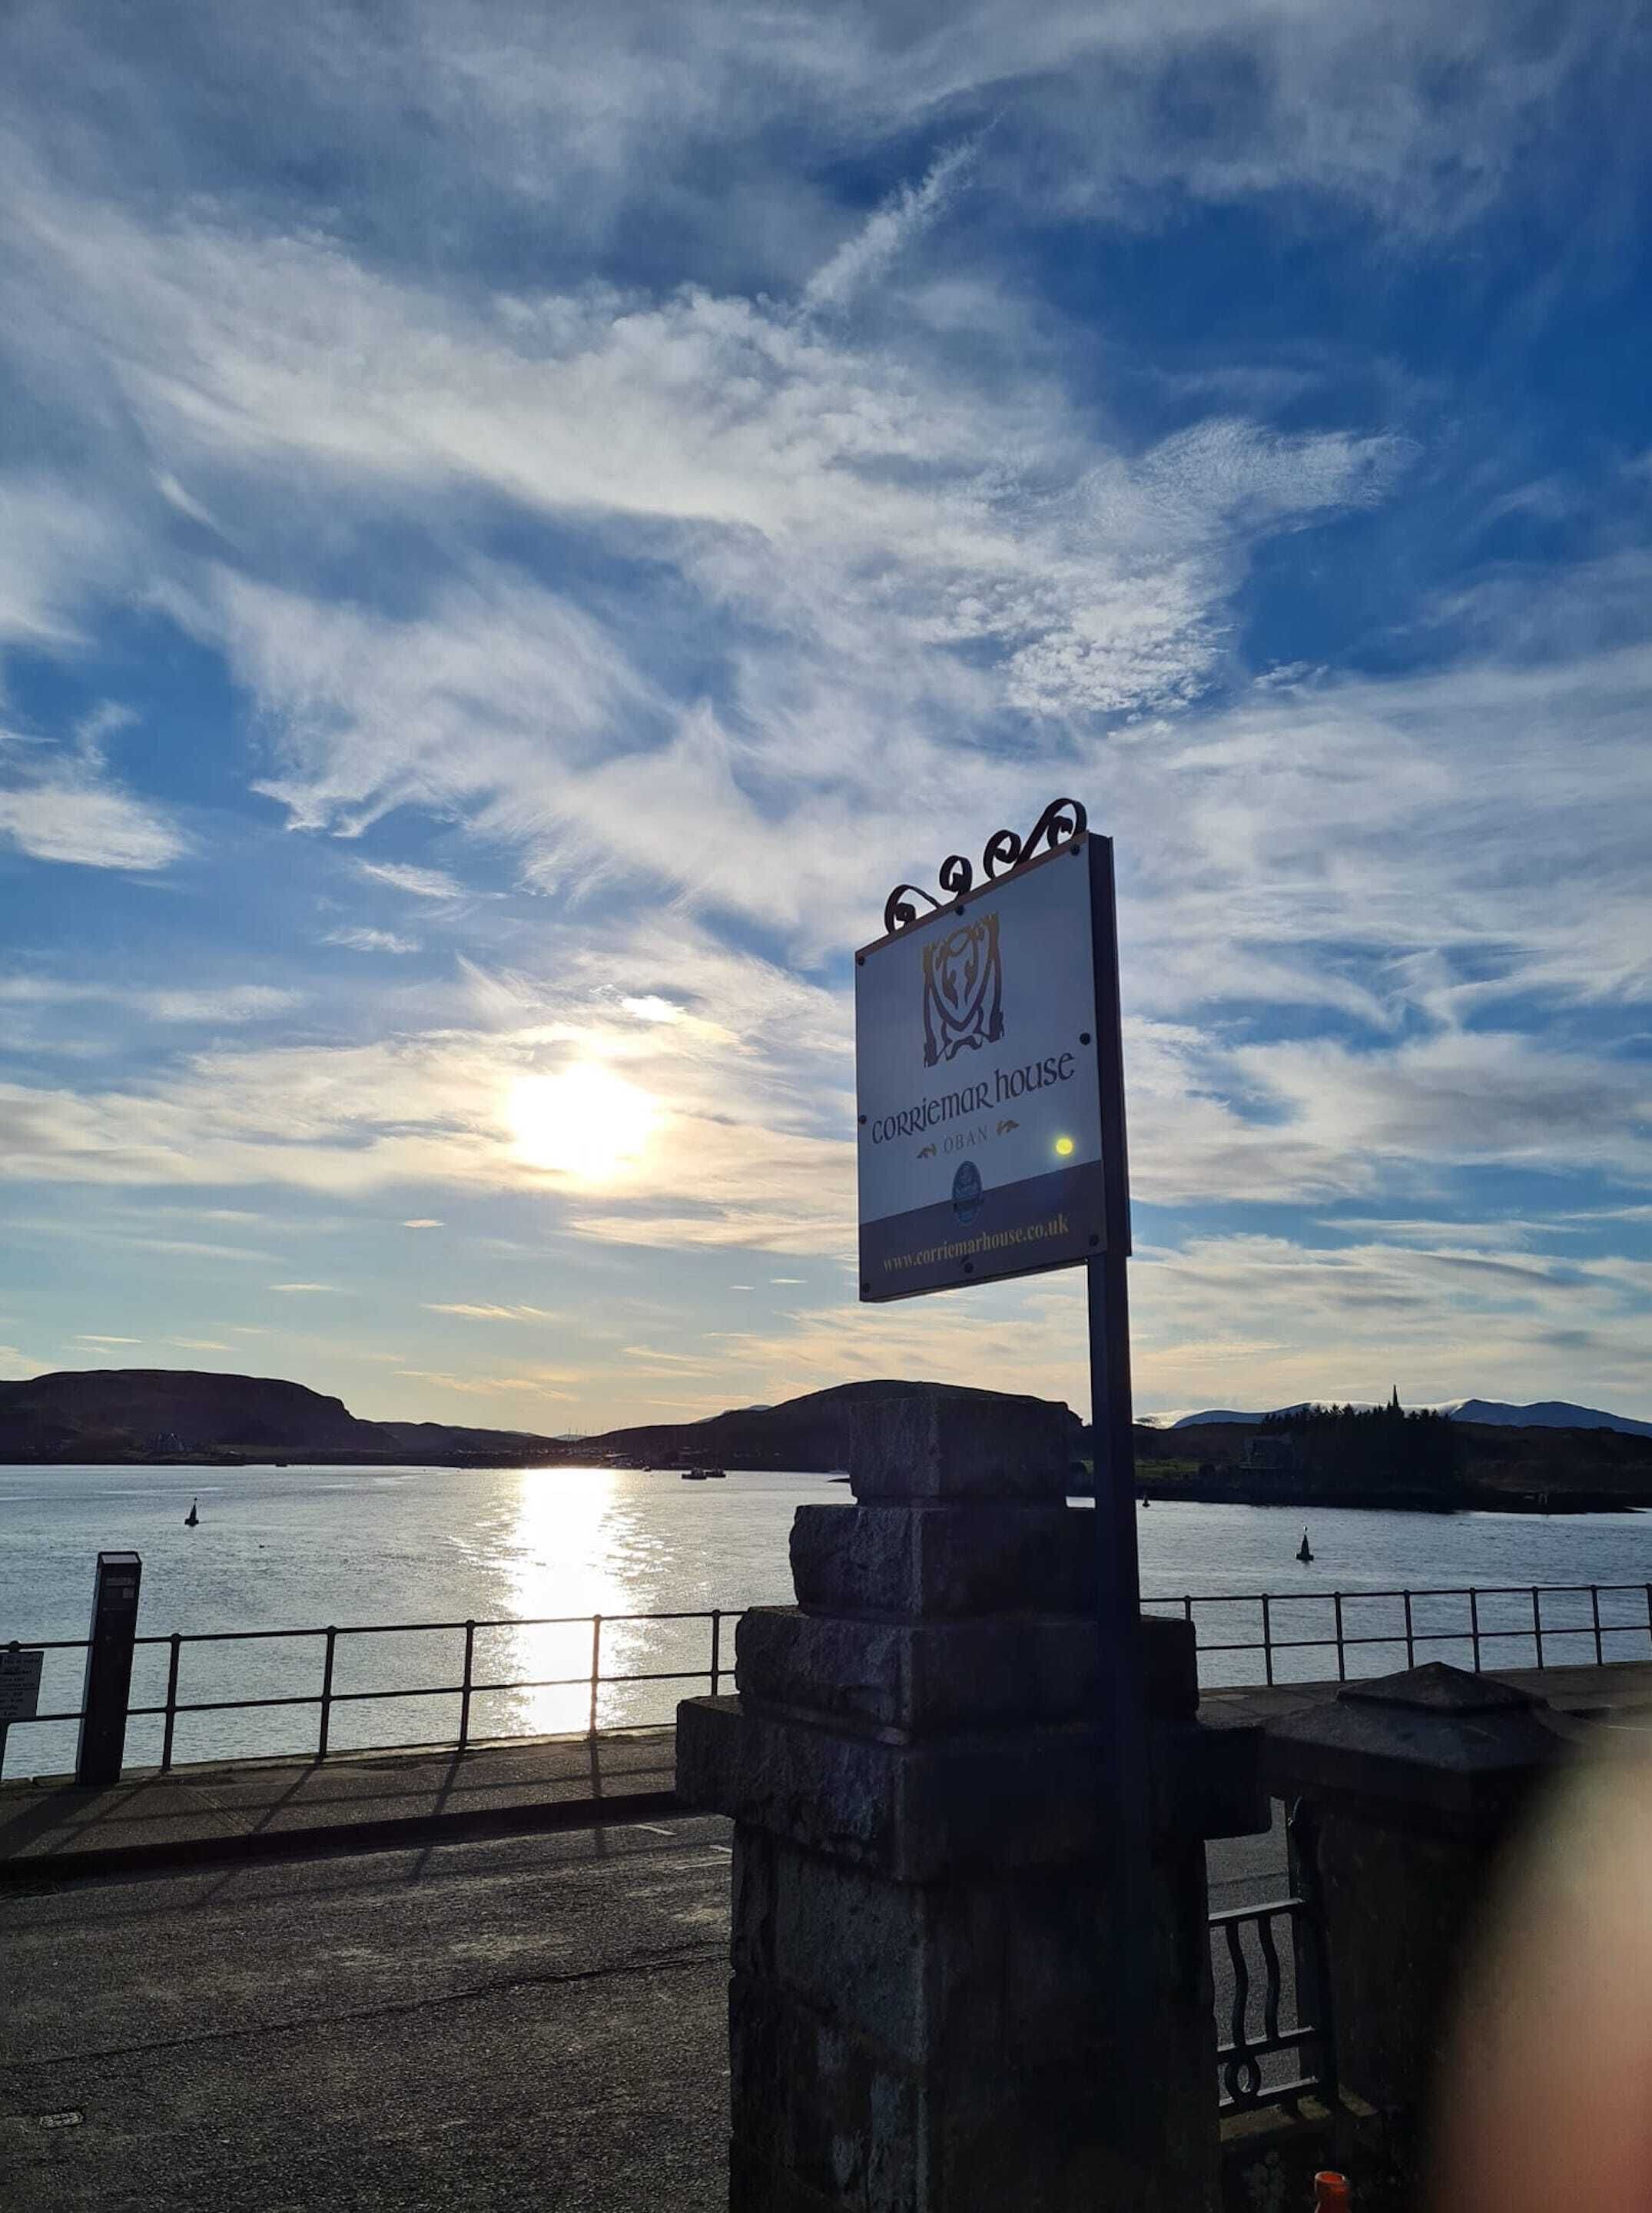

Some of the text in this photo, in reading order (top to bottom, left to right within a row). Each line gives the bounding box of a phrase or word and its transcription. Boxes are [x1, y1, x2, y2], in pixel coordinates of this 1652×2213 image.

[994, 1052, 1075, 1103] house
[943, 1125, 989, 1153] OBAN
[883, 1213, 1070, 1272] www.corriemarhouse.co.uk
